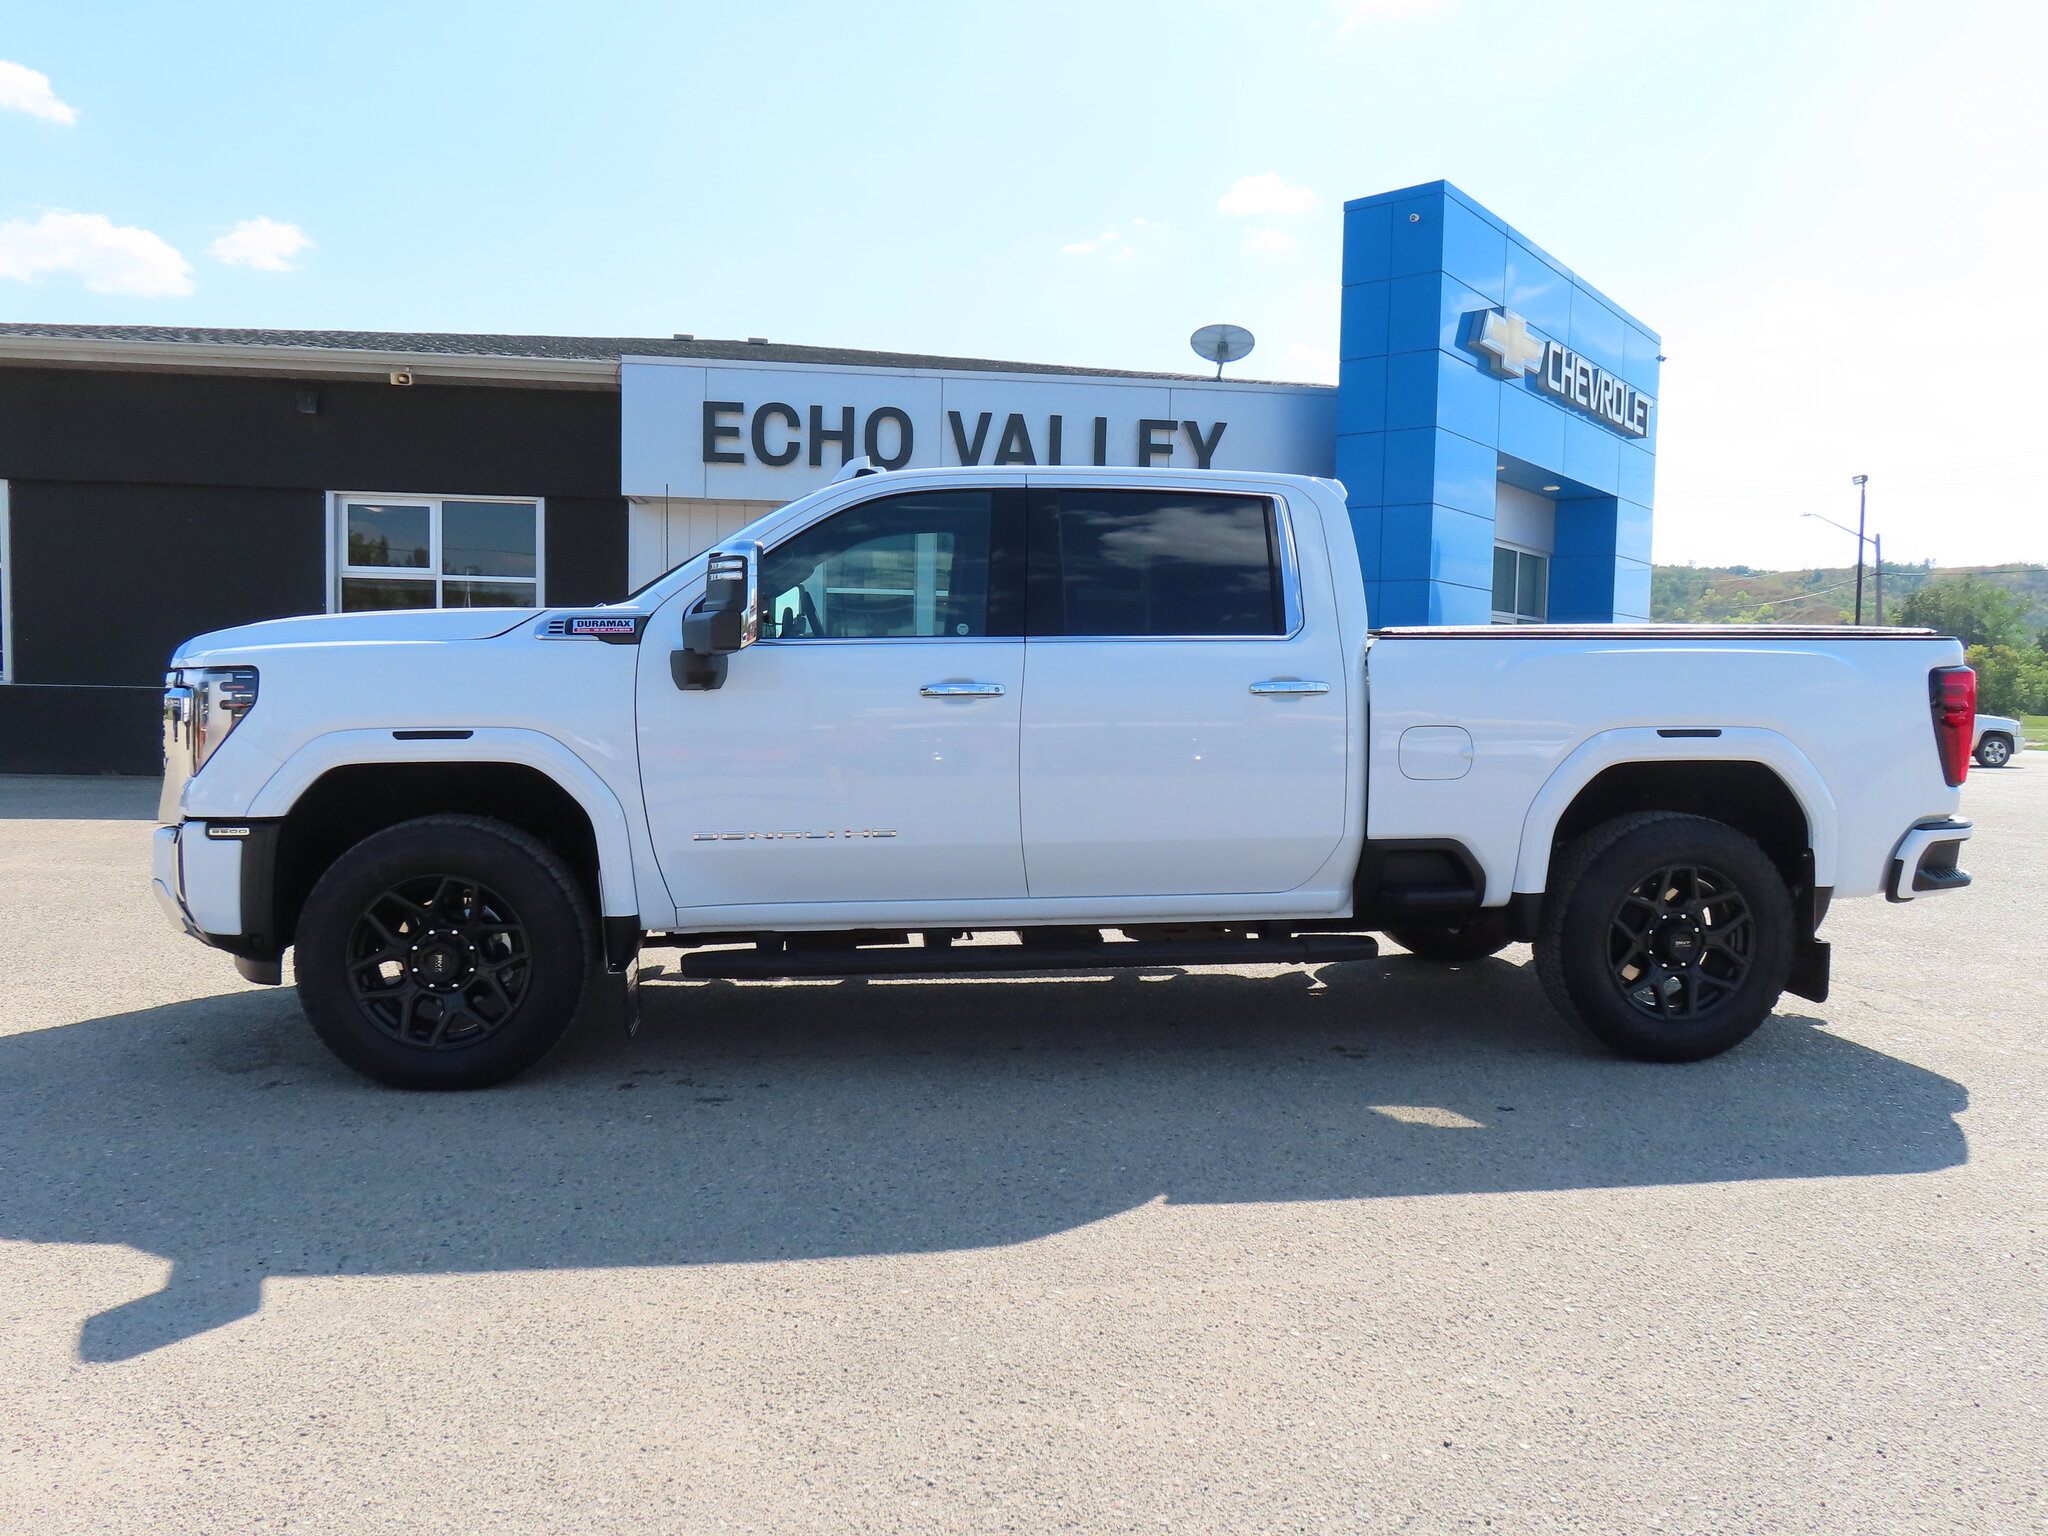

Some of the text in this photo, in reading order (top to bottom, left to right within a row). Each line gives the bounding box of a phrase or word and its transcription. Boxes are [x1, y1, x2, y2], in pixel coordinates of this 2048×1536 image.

[1545, 340, 1654, 437] CHEVROLET
[702, 401, 914, 470] ECHO
[577, 620, 631, 628] DURAMAX
[694, 828, 897, 841] DENALI HD
